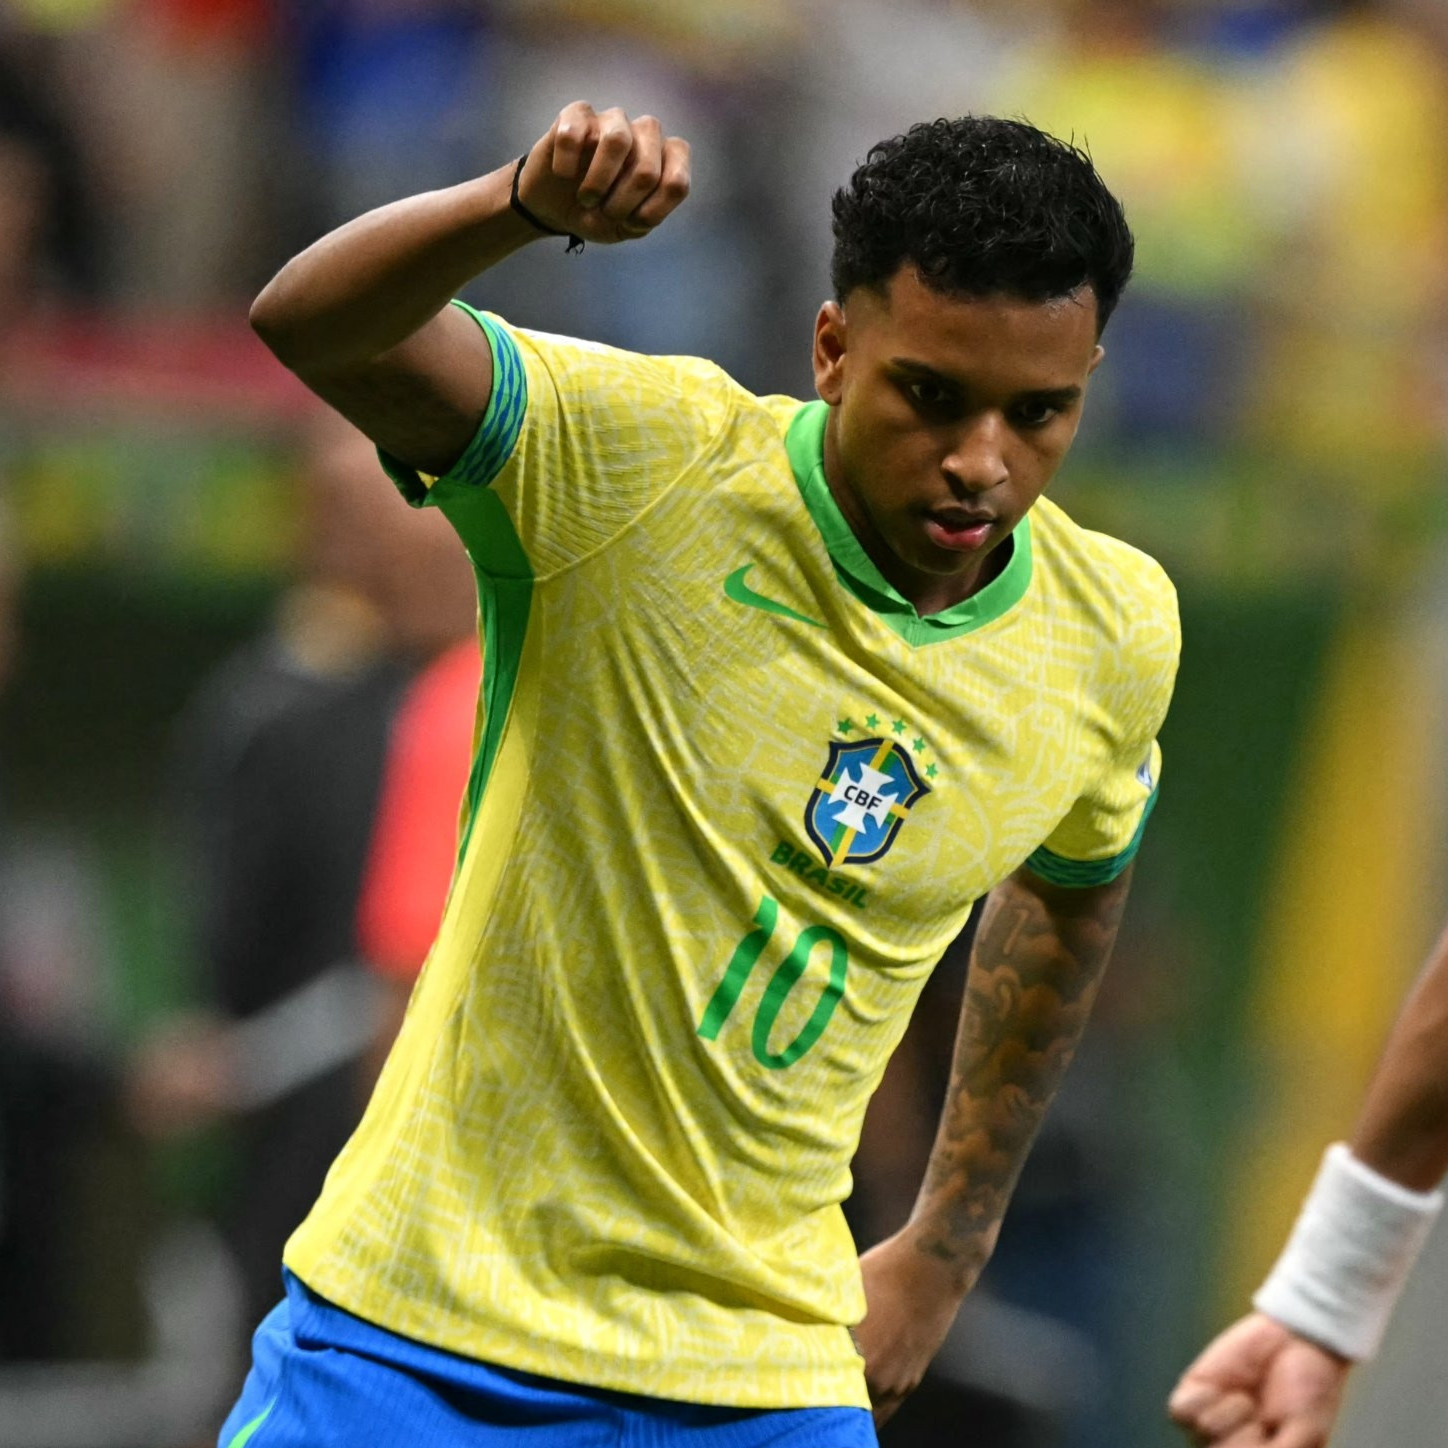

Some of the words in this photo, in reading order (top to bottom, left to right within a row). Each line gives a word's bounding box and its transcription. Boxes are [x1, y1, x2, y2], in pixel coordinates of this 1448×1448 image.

[843, 784, 883, 811] CBF
[769, 840, 867, 910] BRASIL
[695, 894, 850, 1071] 10
